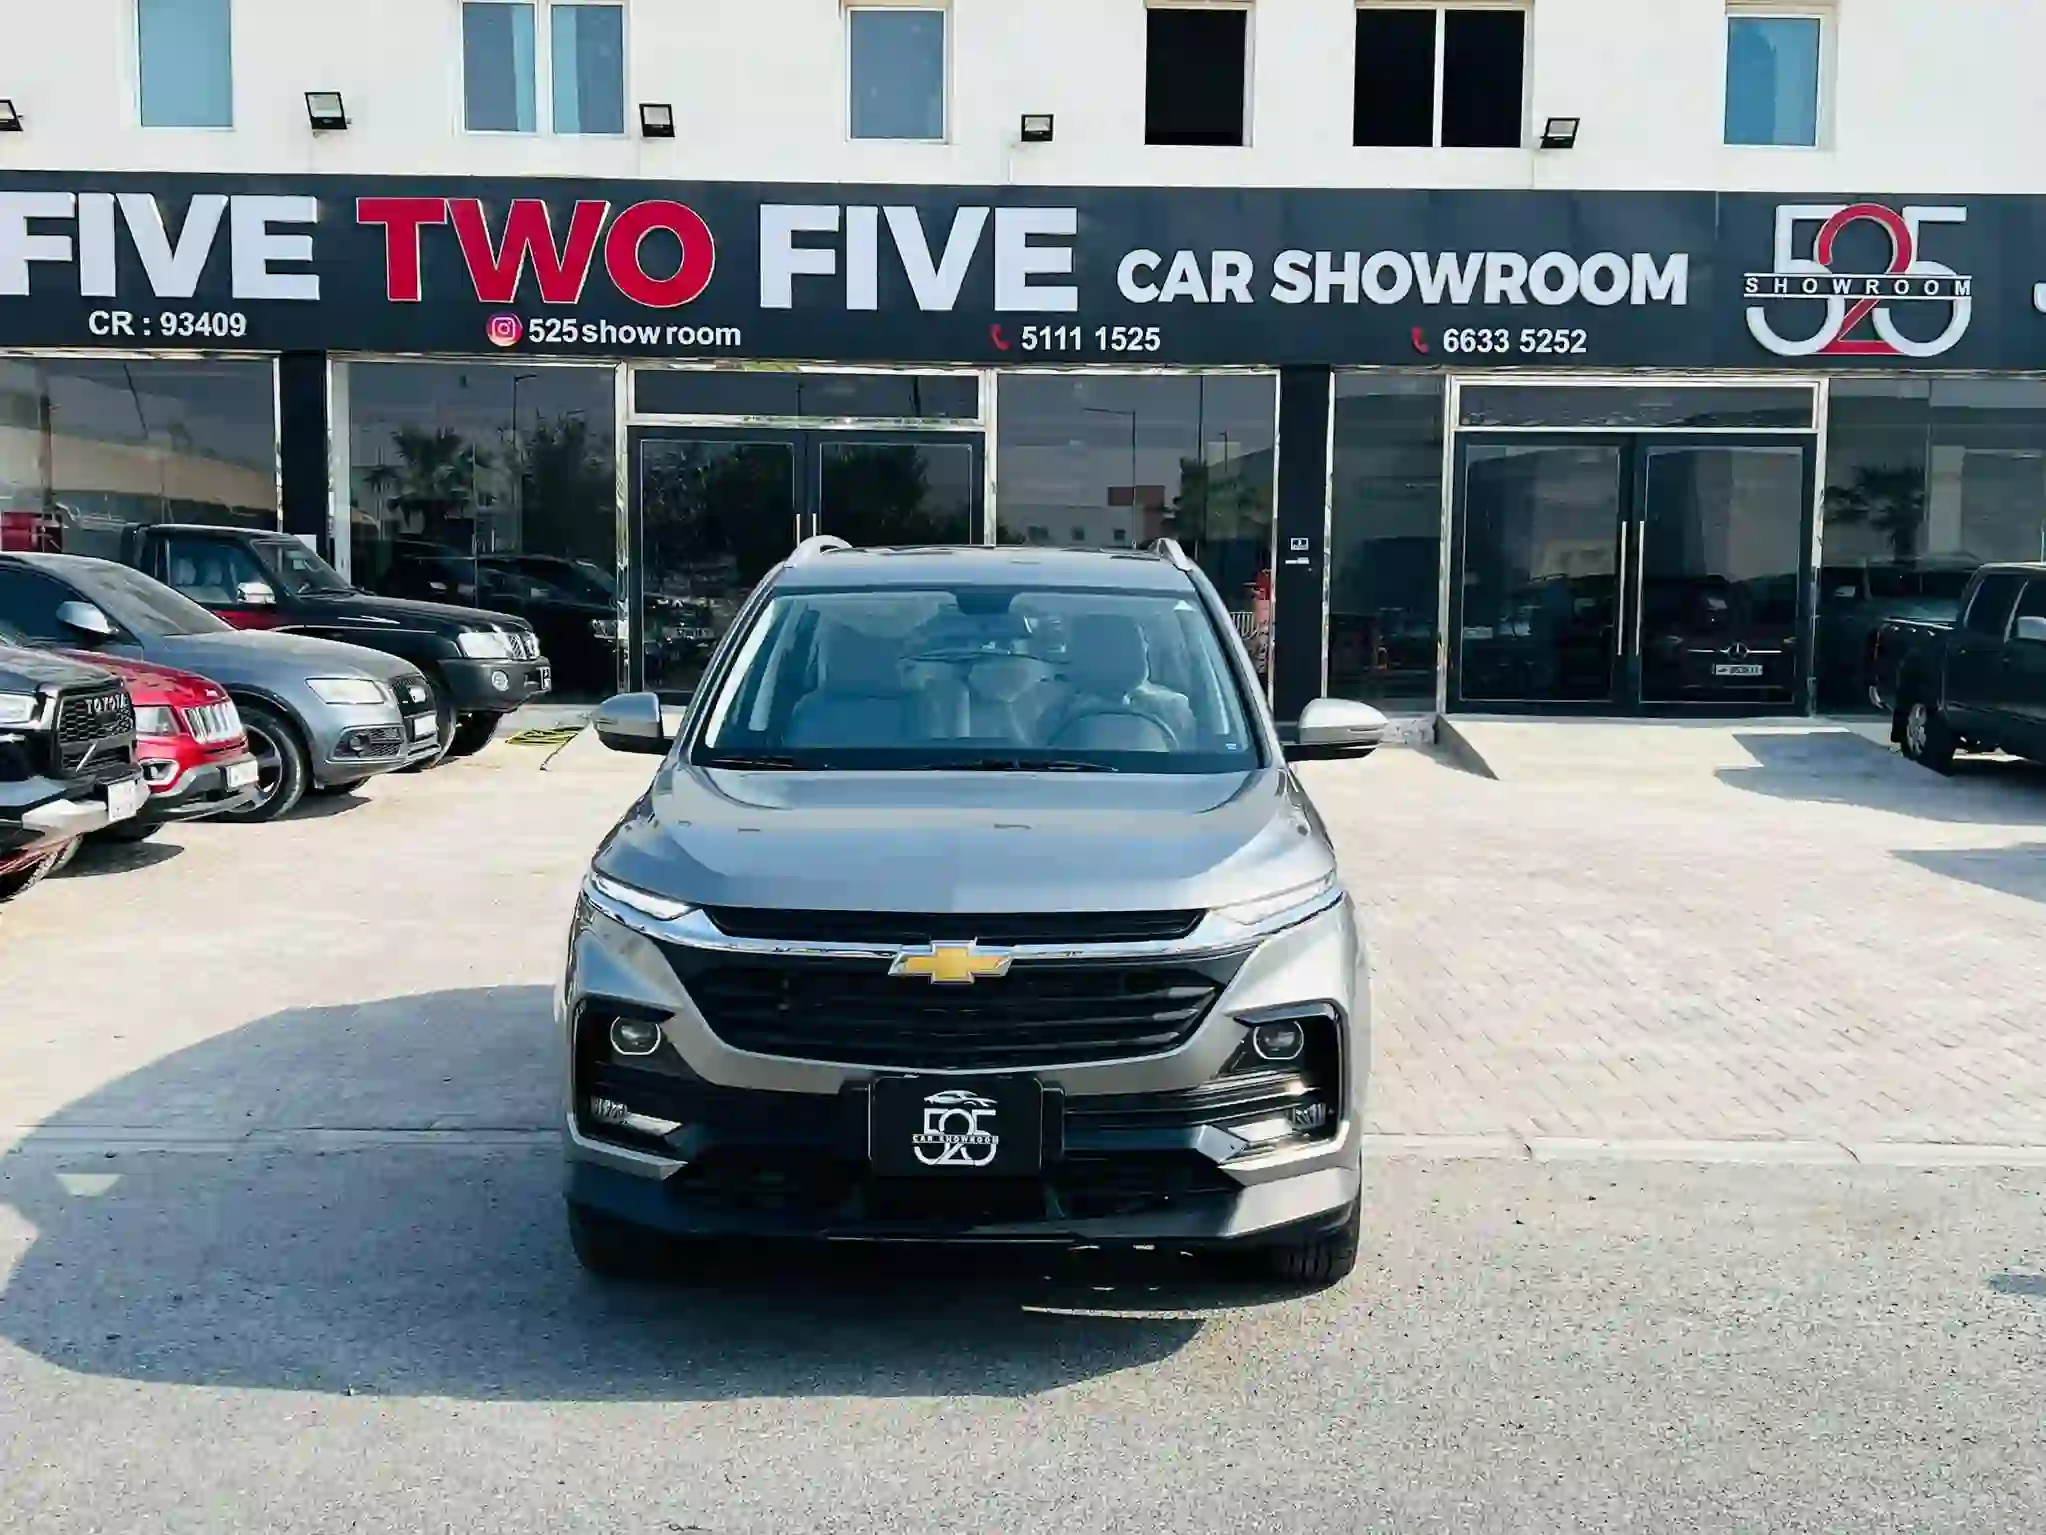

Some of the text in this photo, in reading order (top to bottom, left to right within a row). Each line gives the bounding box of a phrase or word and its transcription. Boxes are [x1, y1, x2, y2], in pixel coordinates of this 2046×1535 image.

[0, 192, 1688, 311] FIVE TWO FIVE CAR SHOWROOM
[1745, 203, 1973, 357] 525
[1745, 277, 1972, 296] SHOWROOM
[88, 310, 135, 335] CR
[160, 311, 247, 336] 93409
[666, 326, 741, 346] room
[1021, 326, 1161, 351] 5111 1525
[1443, 328, 1587, 353] 6633 5252
